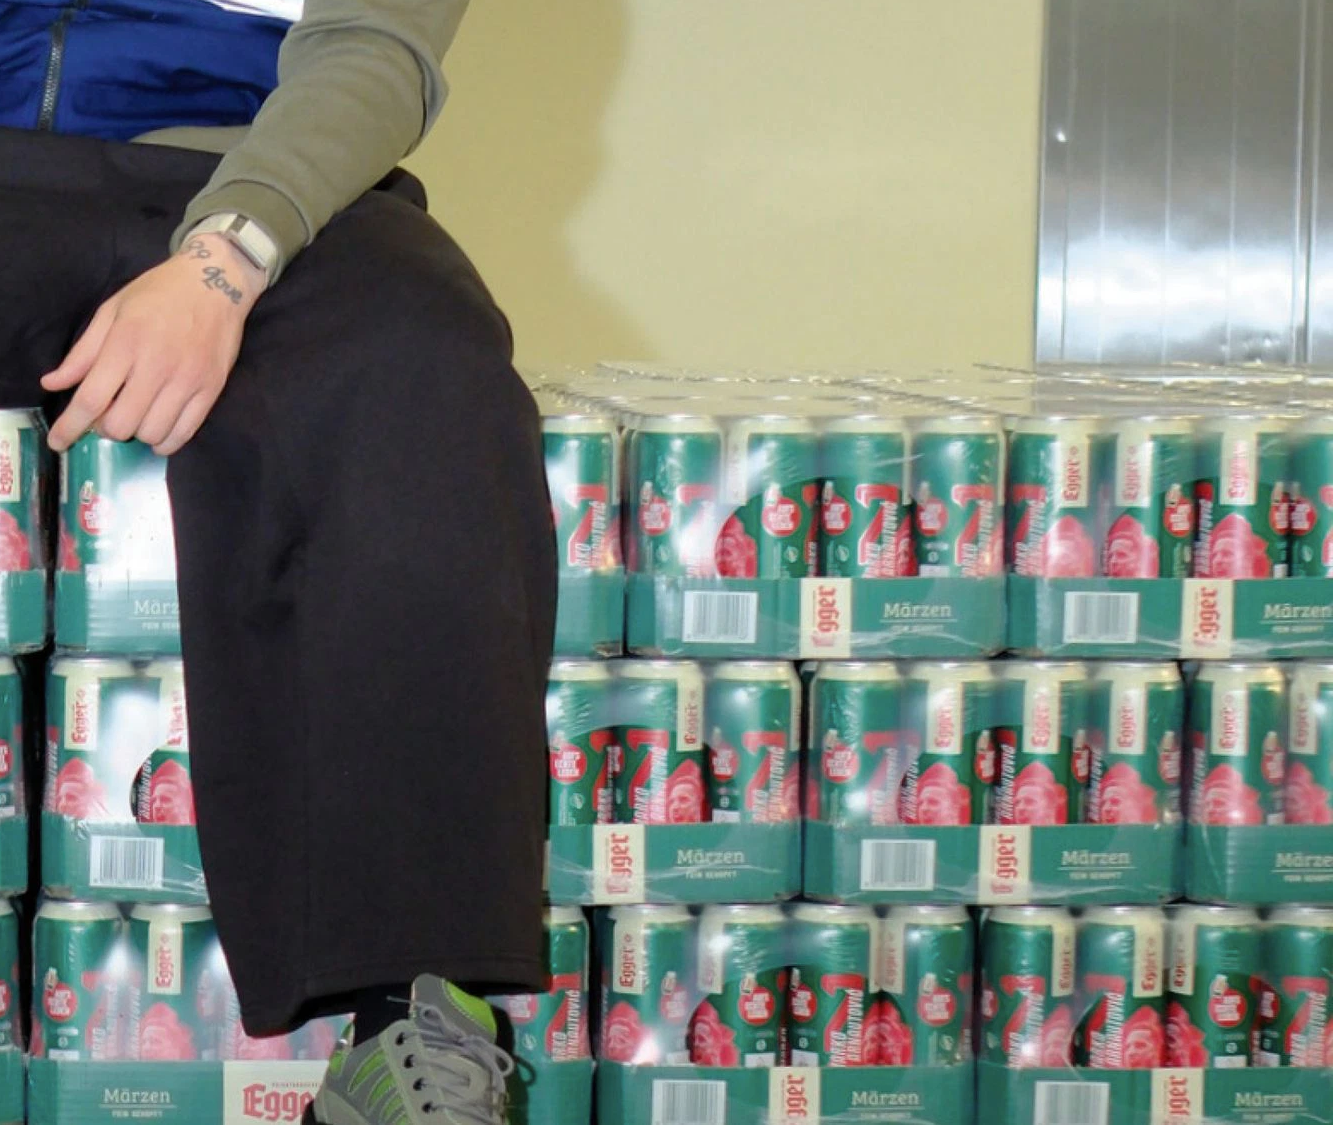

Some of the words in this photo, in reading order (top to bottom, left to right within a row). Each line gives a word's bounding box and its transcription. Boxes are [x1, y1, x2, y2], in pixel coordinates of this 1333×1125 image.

[884, 603, 953, 619] Märzen
[1264, 603, 1332, 620] Märzen
[677, 849, 746, 865] Märzen
[1062, 850, 1130, 865] Märzen
[619, 945, 636, 988] Egger
[103, 1088, 171, 1105] Märzen
[852, 1090, 921, 1106] Märzen
[1235, 1092, 1304, 1107] Märzen
